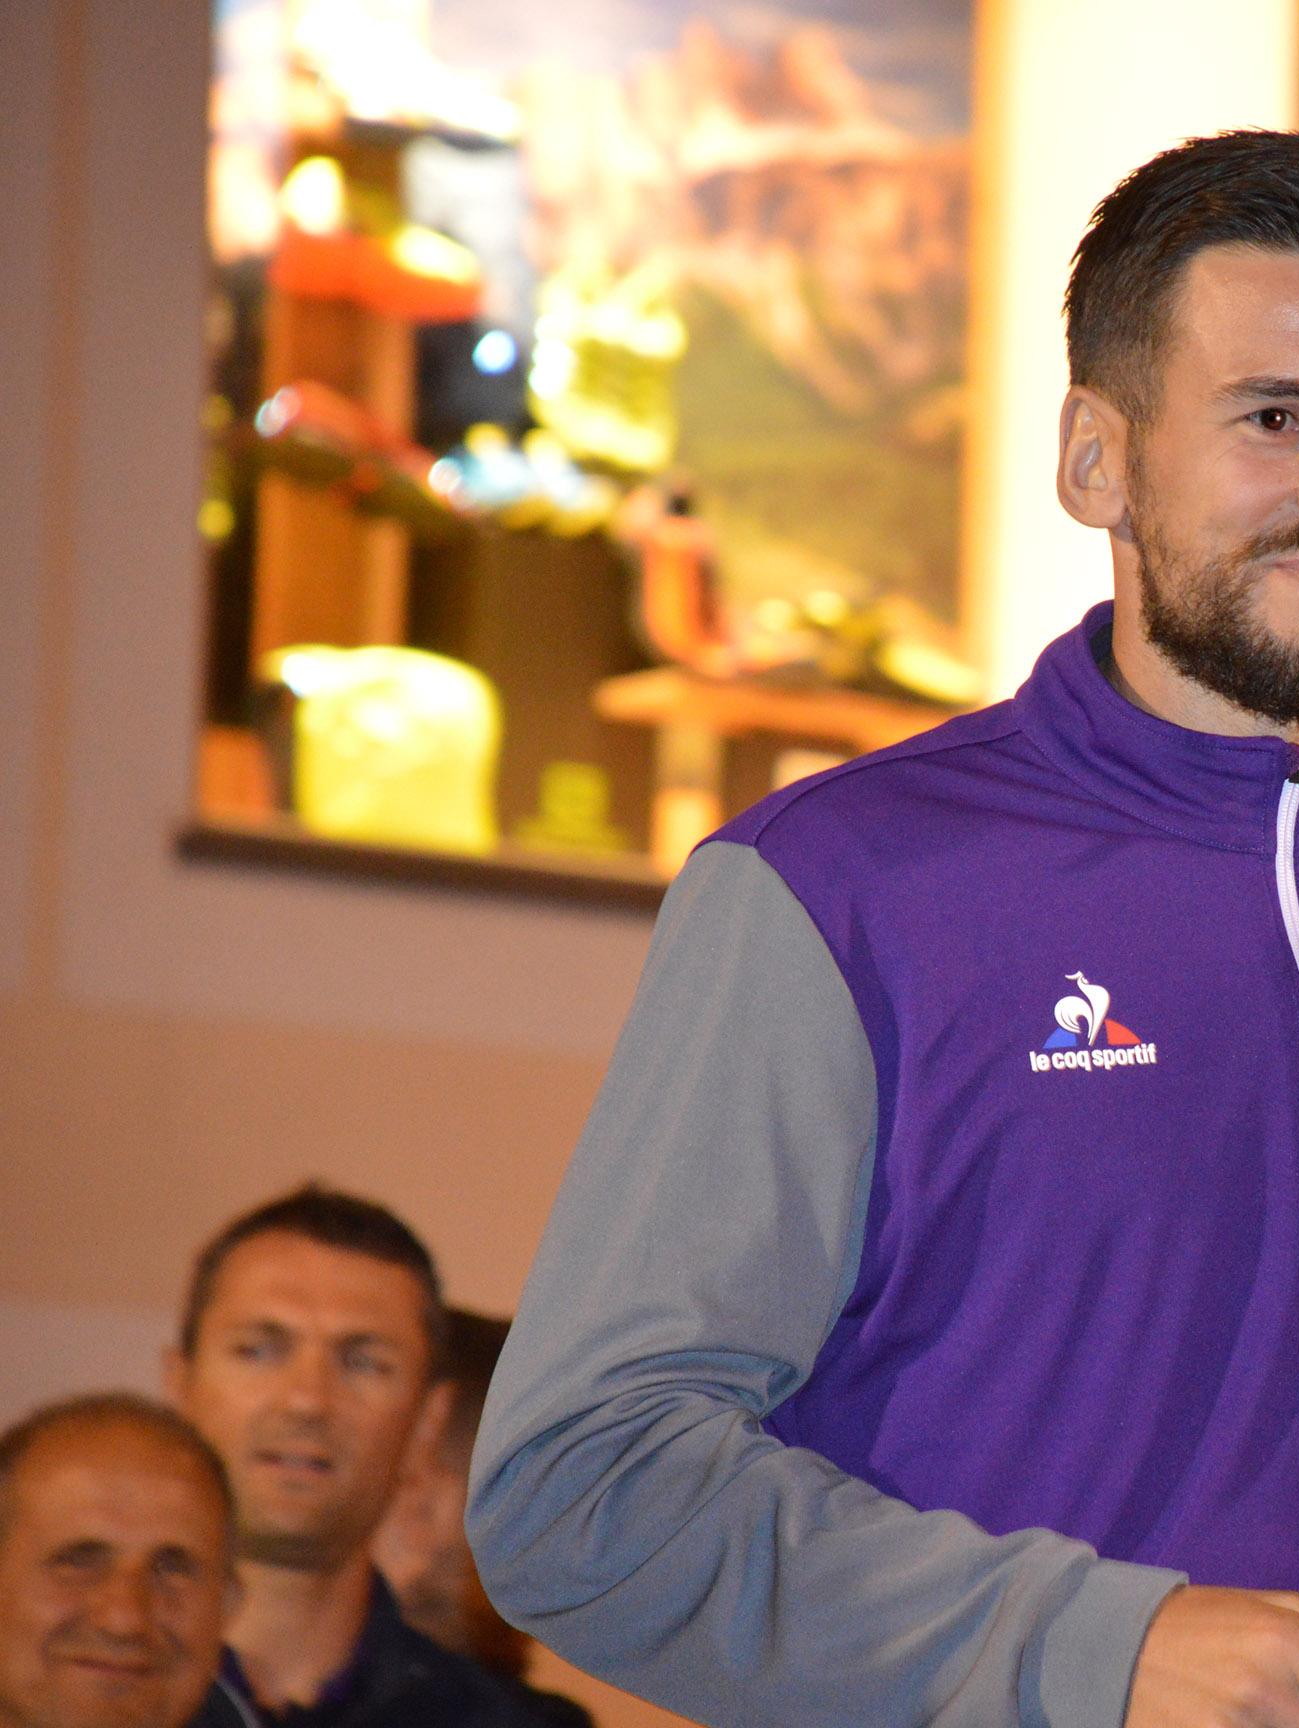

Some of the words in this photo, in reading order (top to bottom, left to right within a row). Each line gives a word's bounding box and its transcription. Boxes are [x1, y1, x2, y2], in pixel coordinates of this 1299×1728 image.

[1029, 1051, 1050, 1072] le
[1051, 1049, 1091, 1072] coq
[1092, 1042, 1157, 1071] sportif
